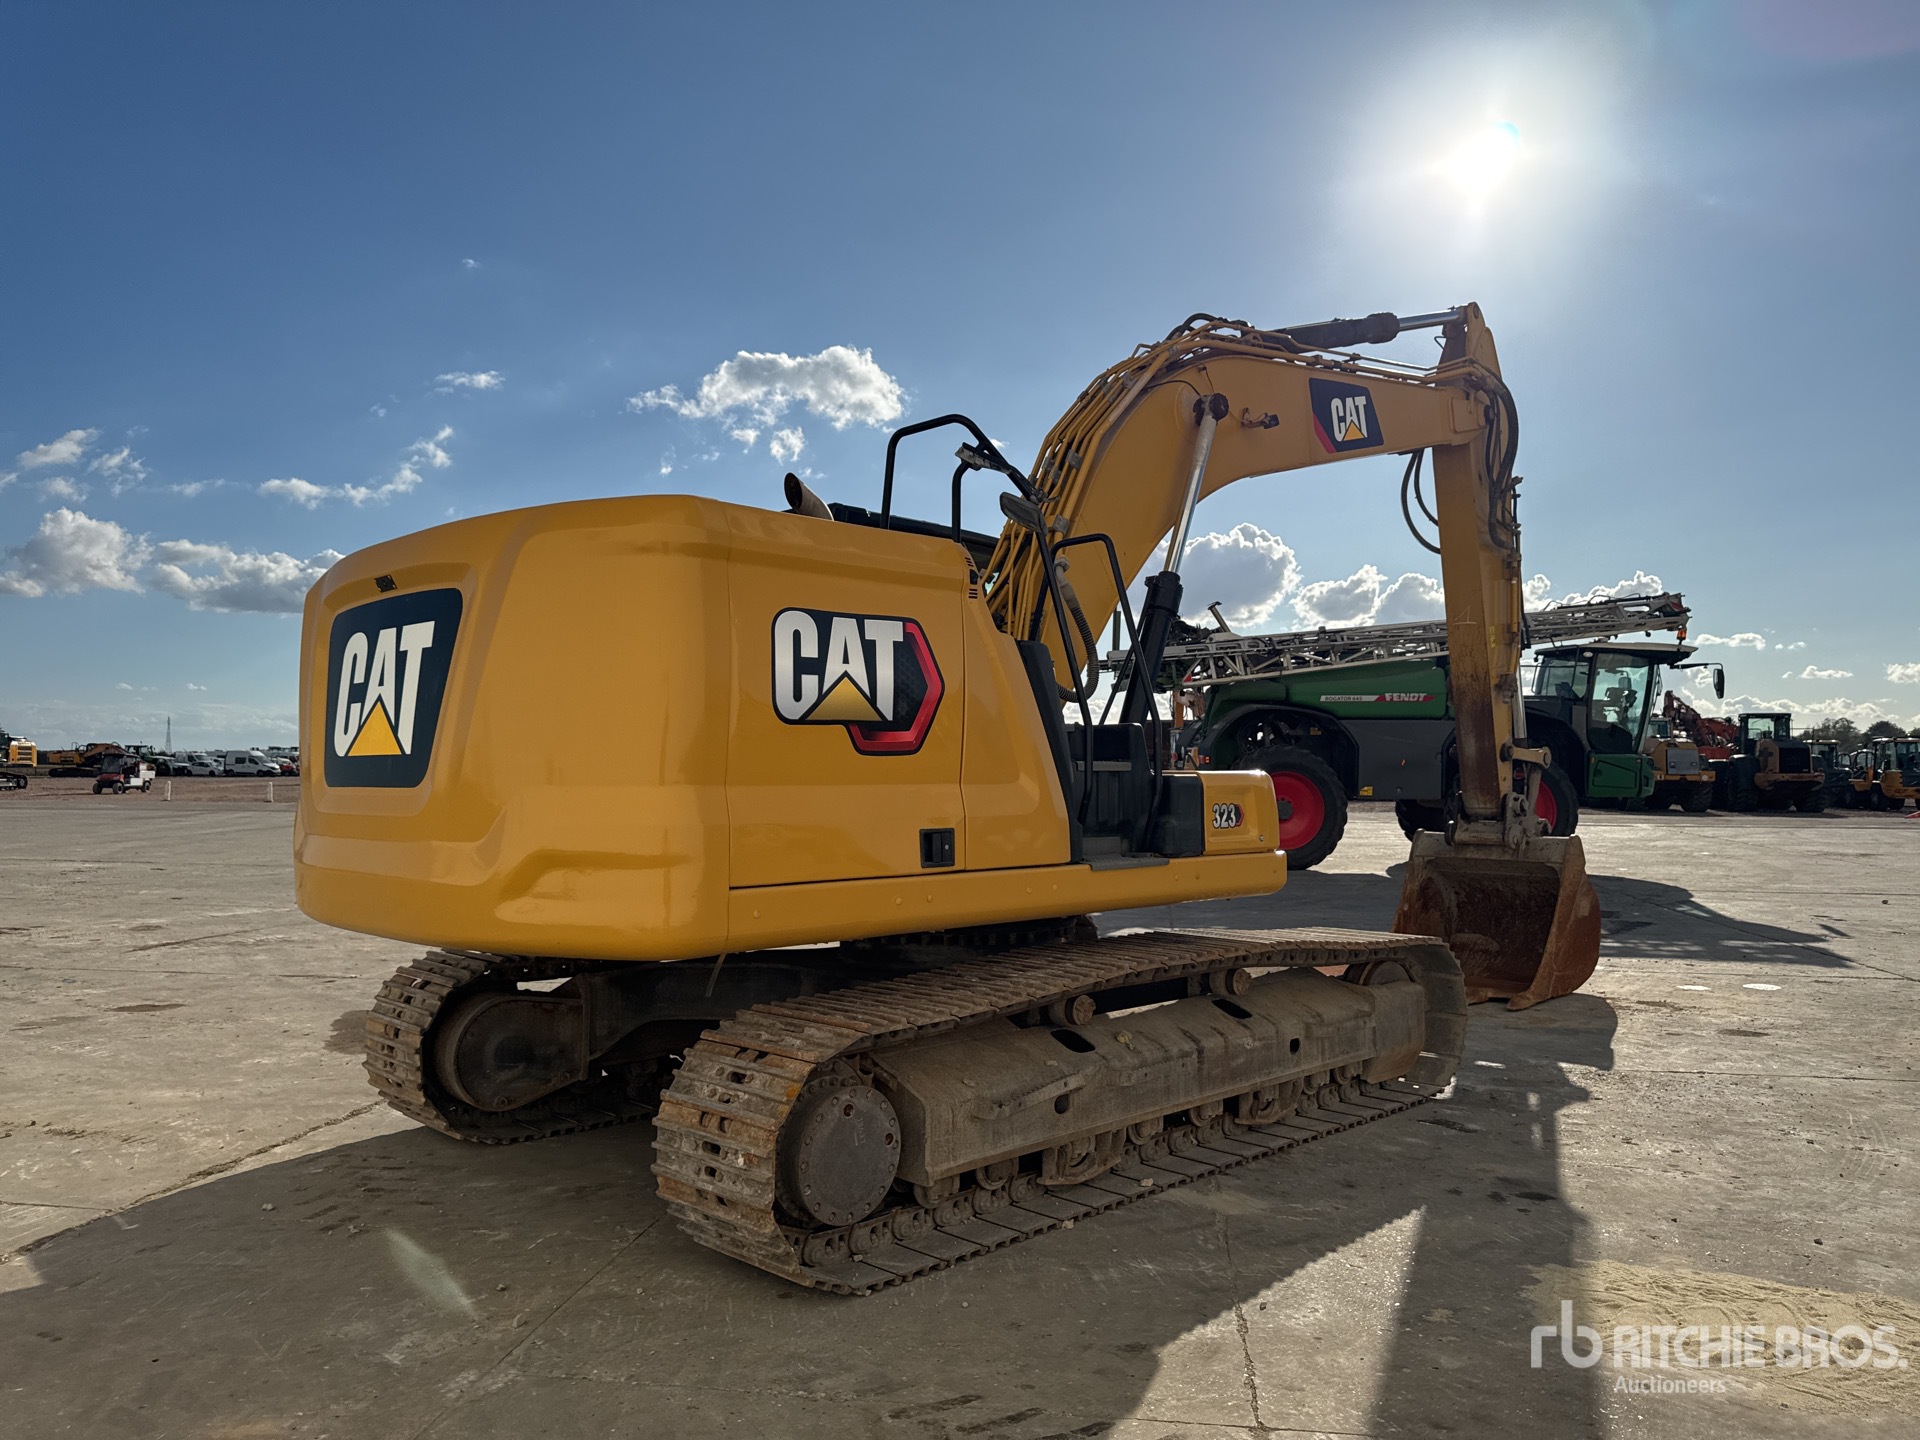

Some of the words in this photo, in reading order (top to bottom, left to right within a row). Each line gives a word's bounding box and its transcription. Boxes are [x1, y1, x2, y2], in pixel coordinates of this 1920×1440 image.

[1331, 396, 1367, 442] CAT
[774, 610, 904, 721] CAT
[333, 621, 435, 757] CAT
[1384, 692, 1427, 702] FENDT
[1212, 803, 1236, 829] 323
